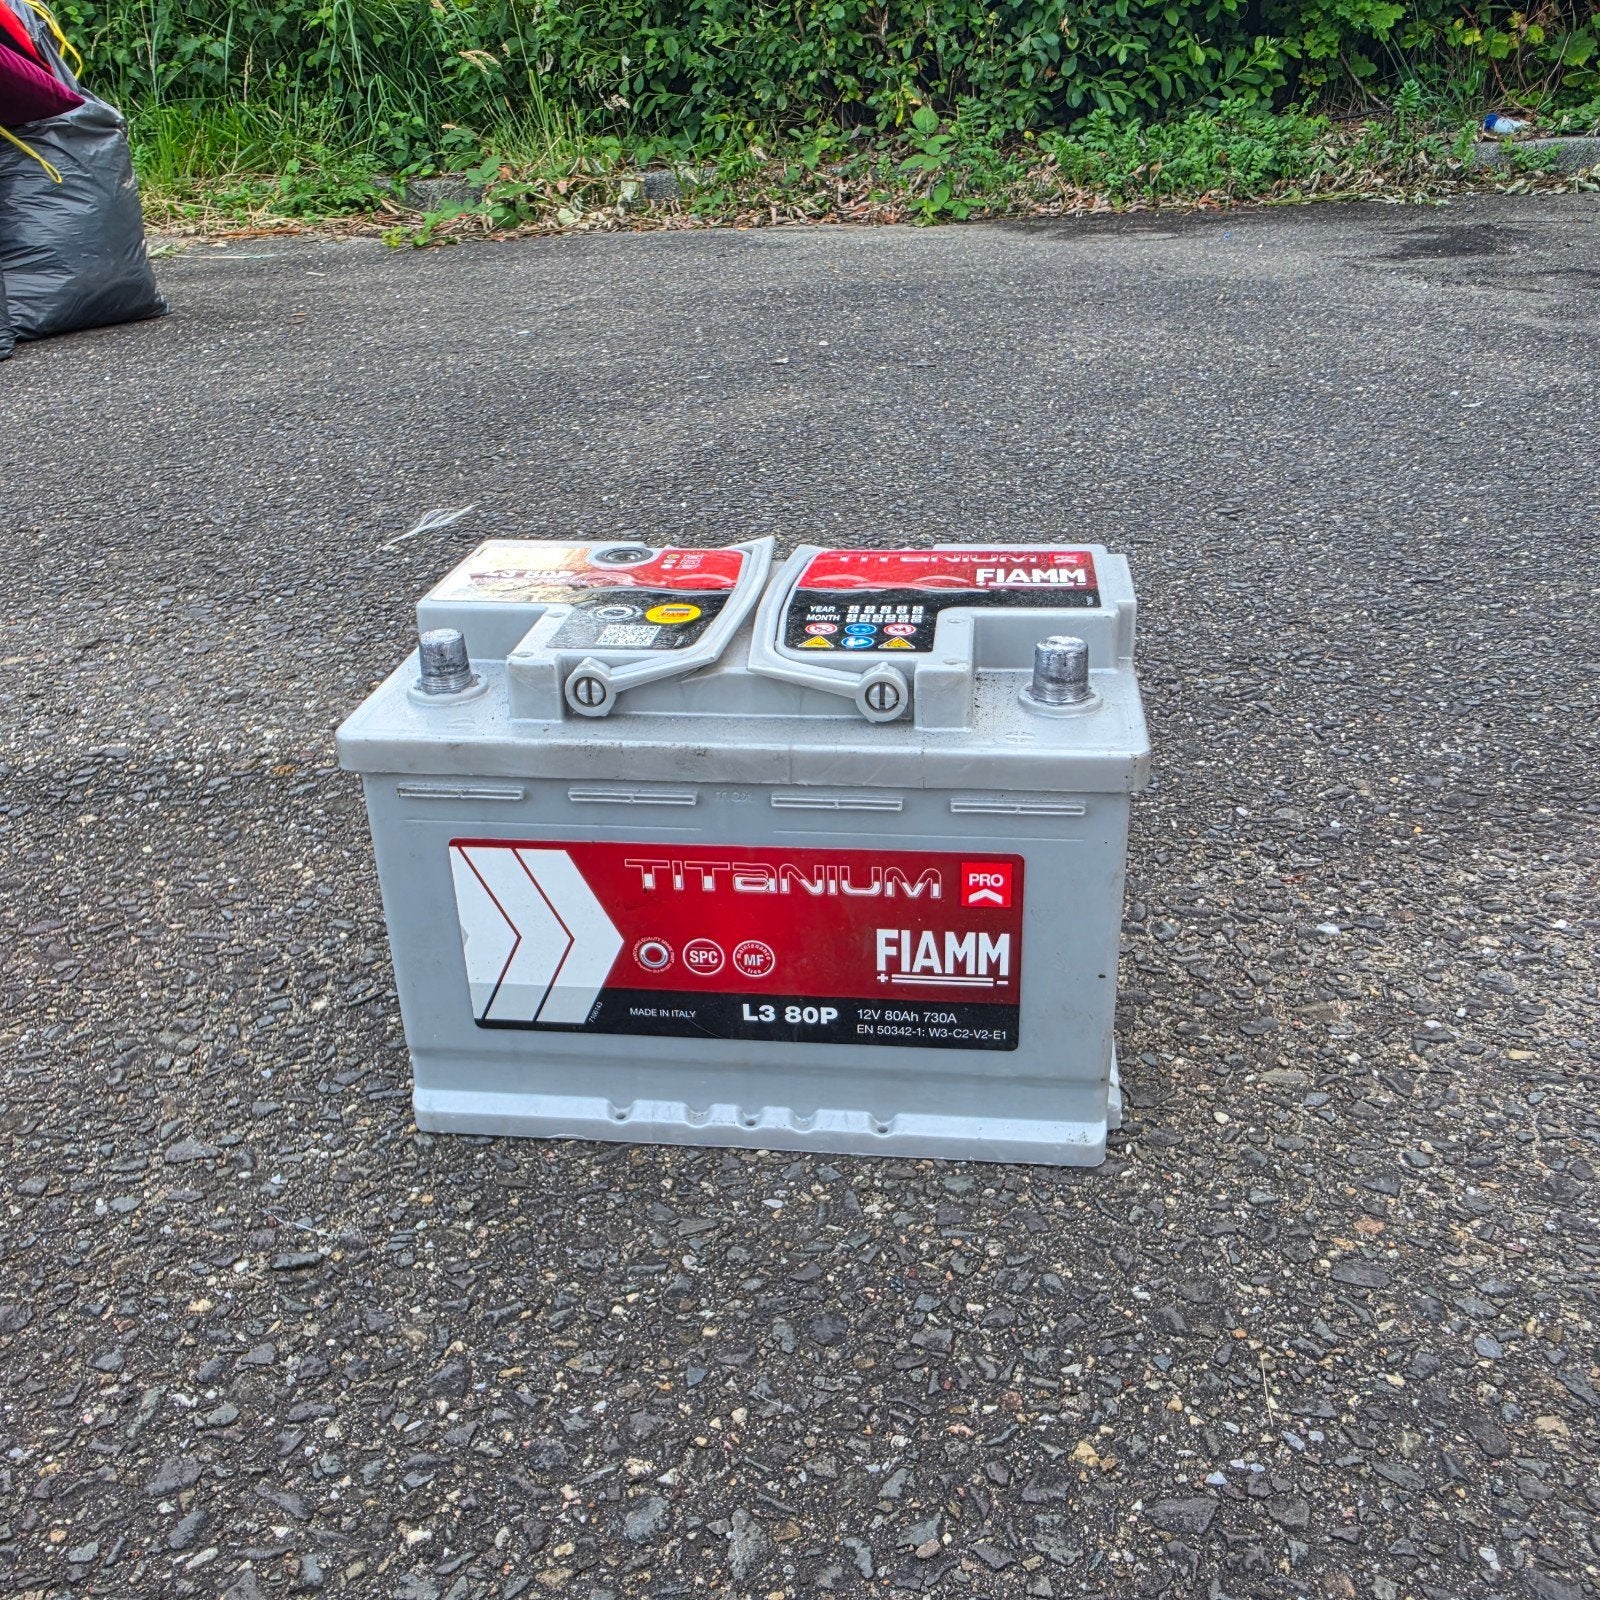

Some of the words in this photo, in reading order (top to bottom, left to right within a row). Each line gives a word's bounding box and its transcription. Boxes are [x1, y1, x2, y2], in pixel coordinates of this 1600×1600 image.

[976, 568, 1087, 583] FIAMM
[968, 873, 1004, 887] PRO
[690, 950, 718, 964] SPC
[744, 954, 764, 966] MF
[877, 929, 1010, 976] FIAMM
[629, 1007, 657, 1017] MADE
[660, 1009, 669, 1017] IN
[671, 1009, 697, 1018] ITALY
[742, 1003, 776, 1022] L3
[784, 1006, 838, 1025] 80P
[857, 1009, 881, 1020] 12V
[884, 1010, 919, 1022] 80Ah
[923, 1012, 957, 1024] 730A
[857, 1024, 874, 1034] EN
[877, 1026, 925, 1037] 50342-1:
[928, 1029, 1007, 1040] W3-C2-V2-E1
